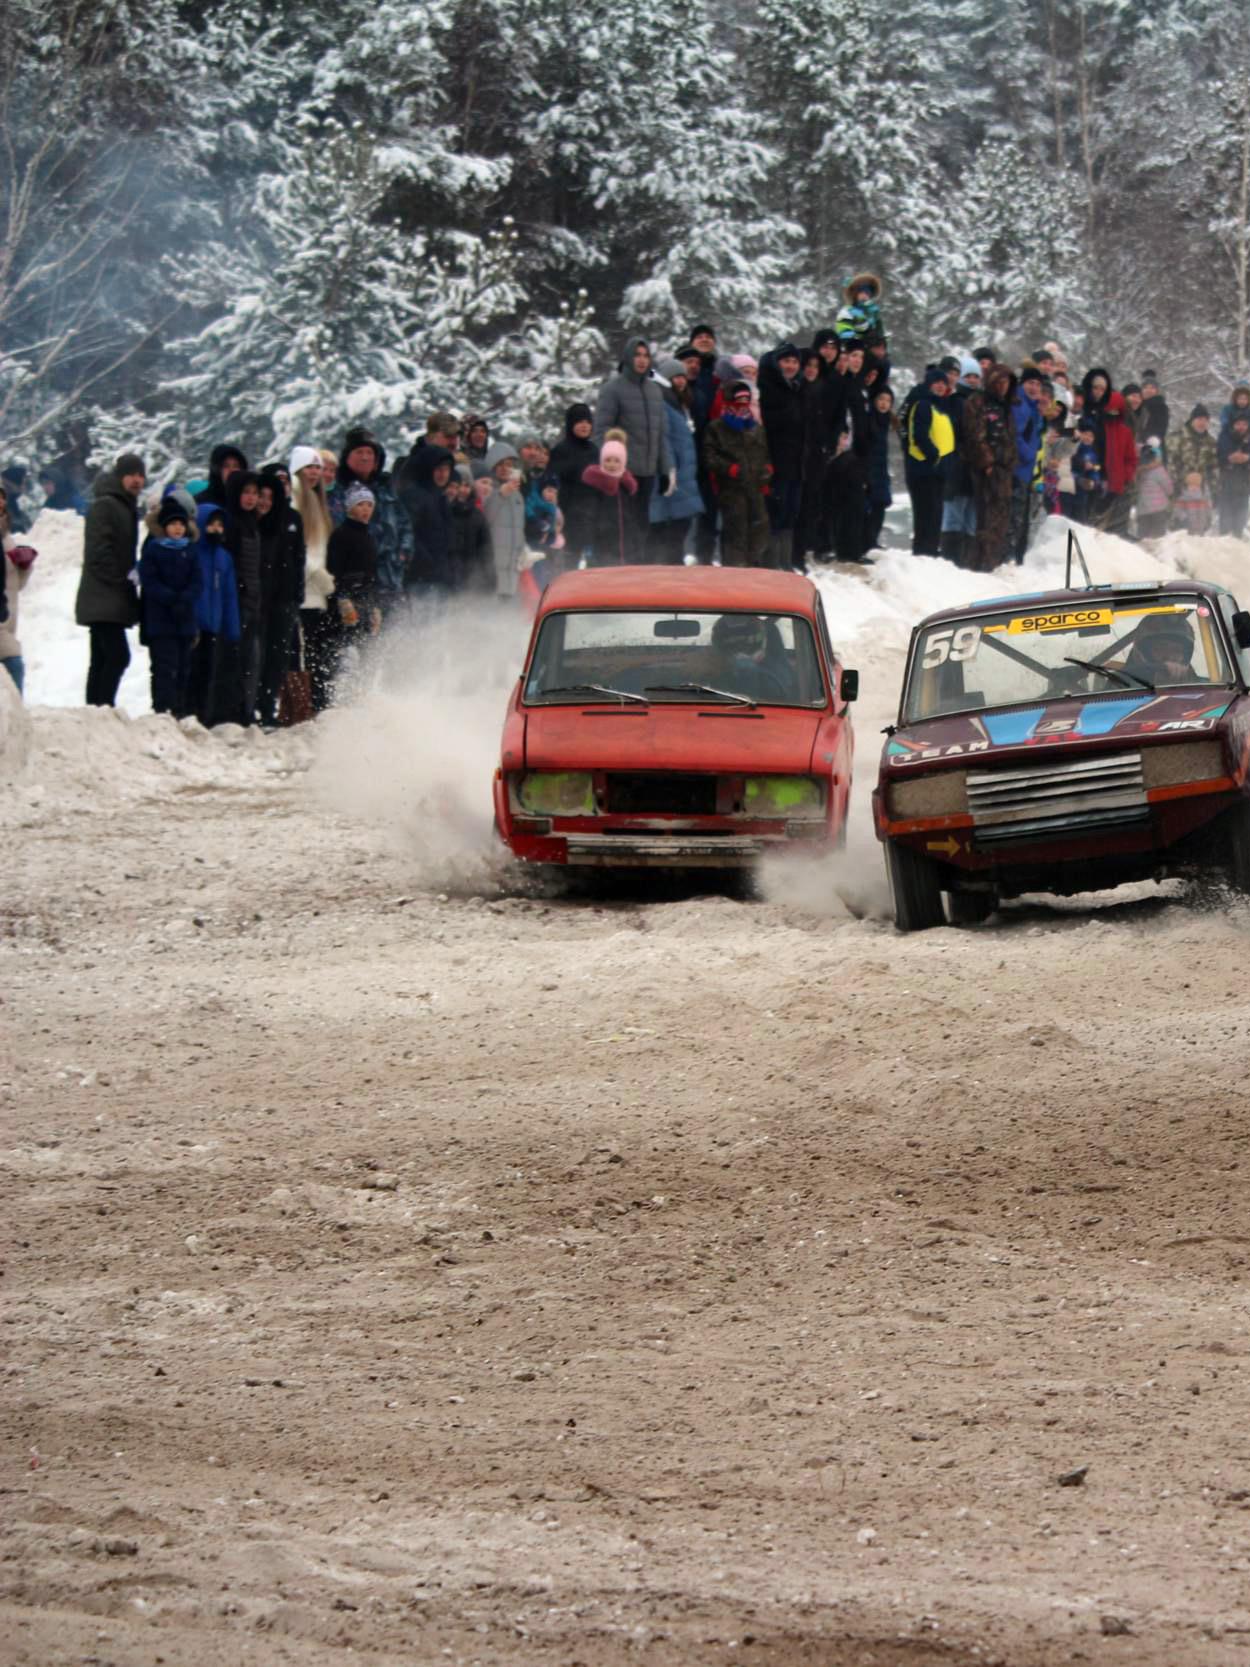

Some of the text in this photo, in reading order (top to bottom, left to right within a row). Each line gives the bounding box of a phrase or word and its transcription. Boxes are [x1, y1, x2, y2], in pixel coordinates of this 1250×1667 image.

[1021, 611, 1101, 631] sparco
[922, 624, 983, 670] 59
[900, 740, 990, 762] TEAM
